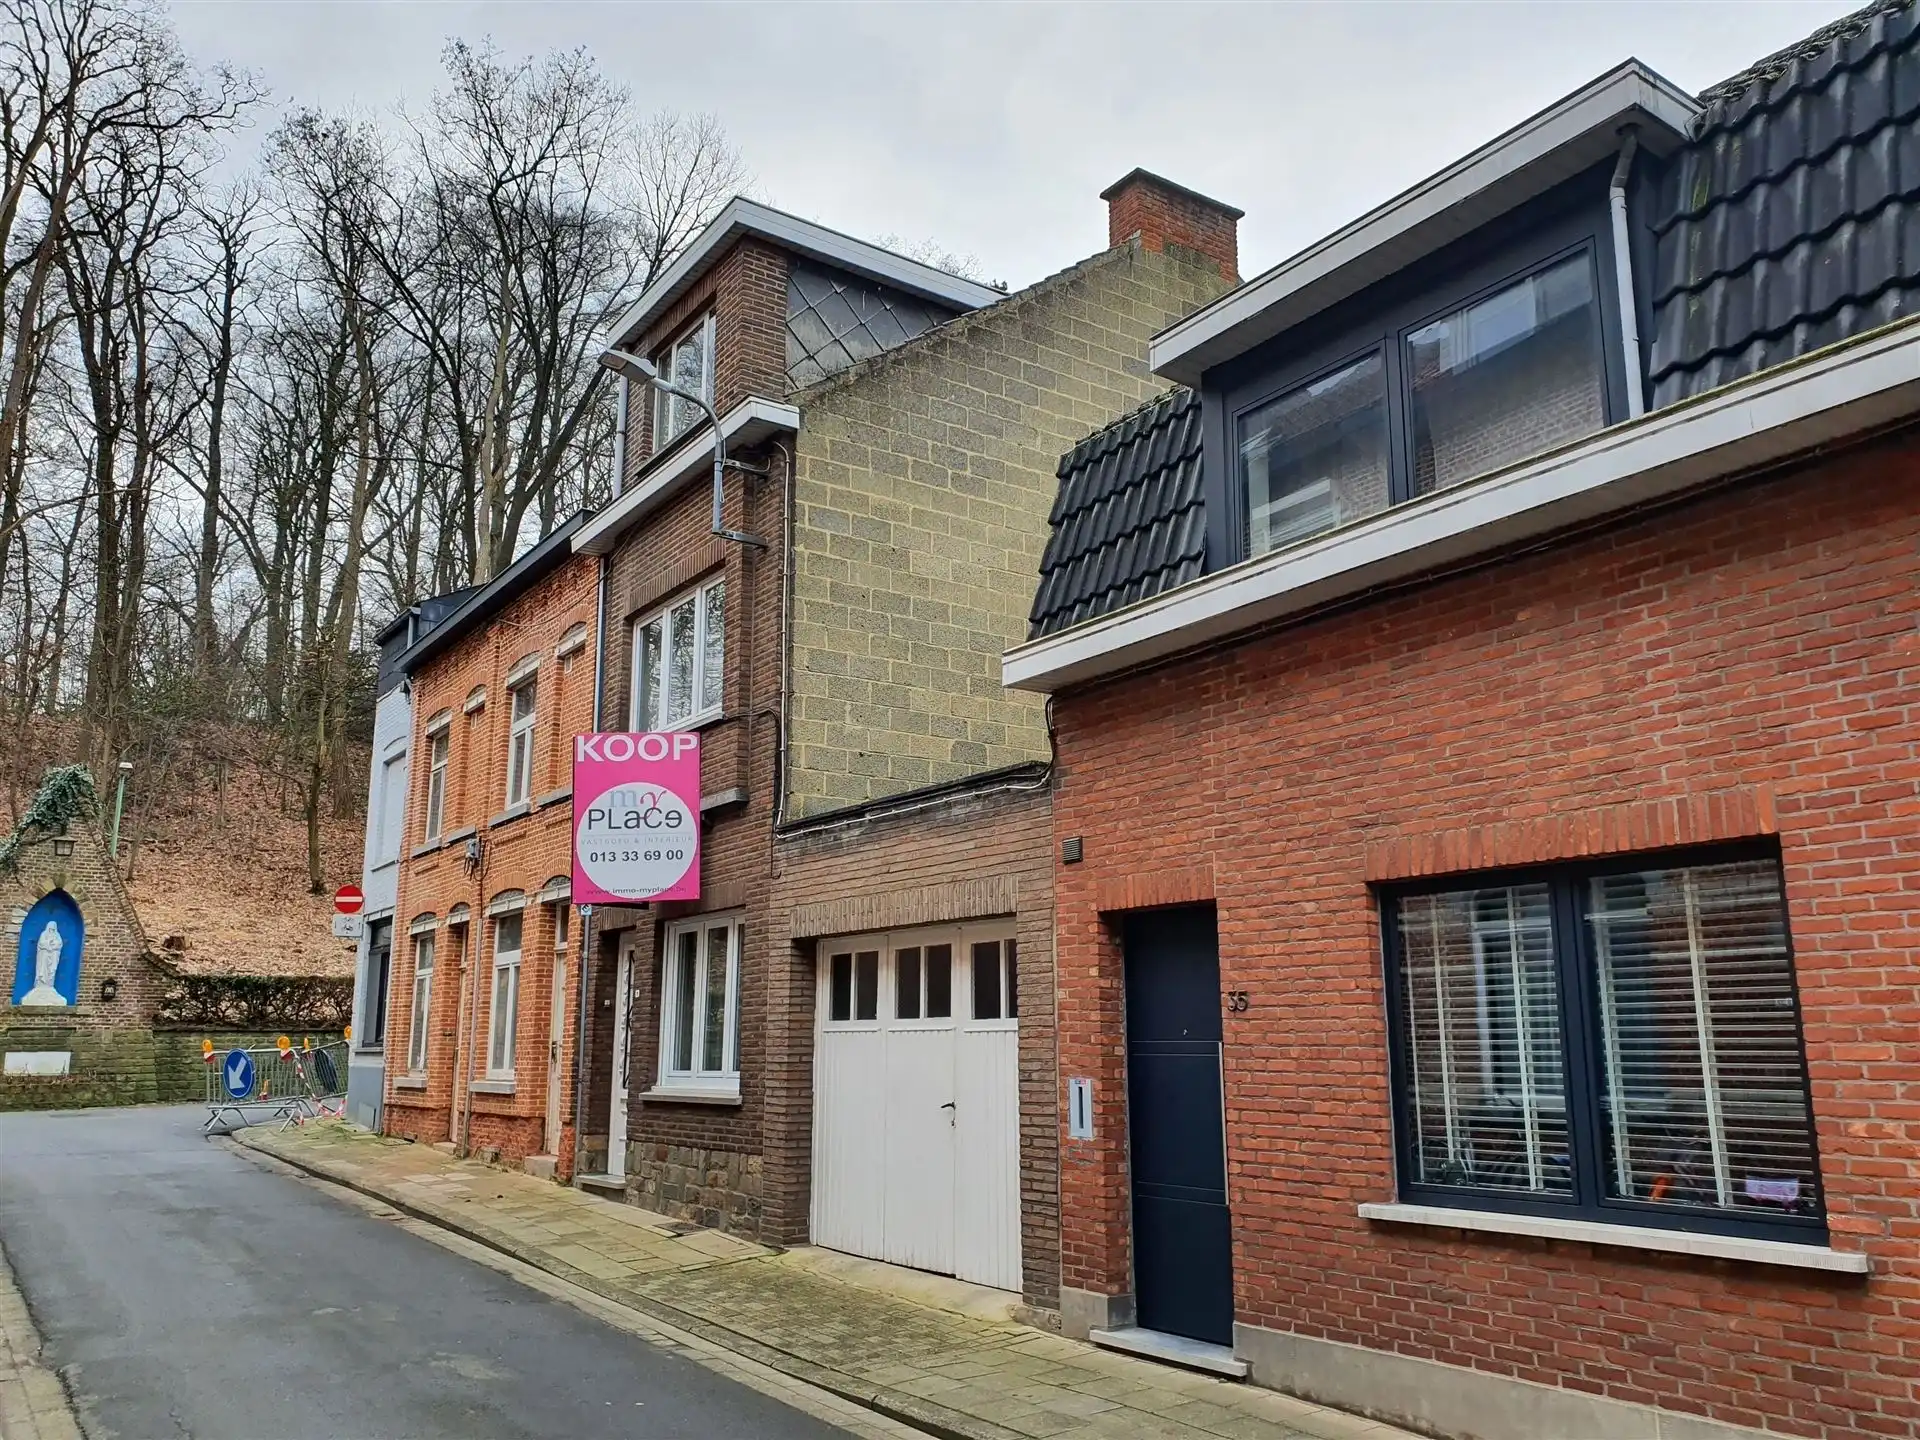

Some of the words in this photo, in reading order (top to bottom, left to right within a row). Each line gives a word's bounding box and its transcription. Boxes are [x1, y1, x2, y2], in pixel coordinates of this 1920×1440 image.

[577, 734, 698, 762] KOOP
[606, 789, 667, 820] my
[590, 851, 616, 862] 013
[621, 850, 639, 861] 33
[643, 850, 661, 861] 69
[666, 849, 684, 860] 00
[1227, 990, 1248, 1013] 35
